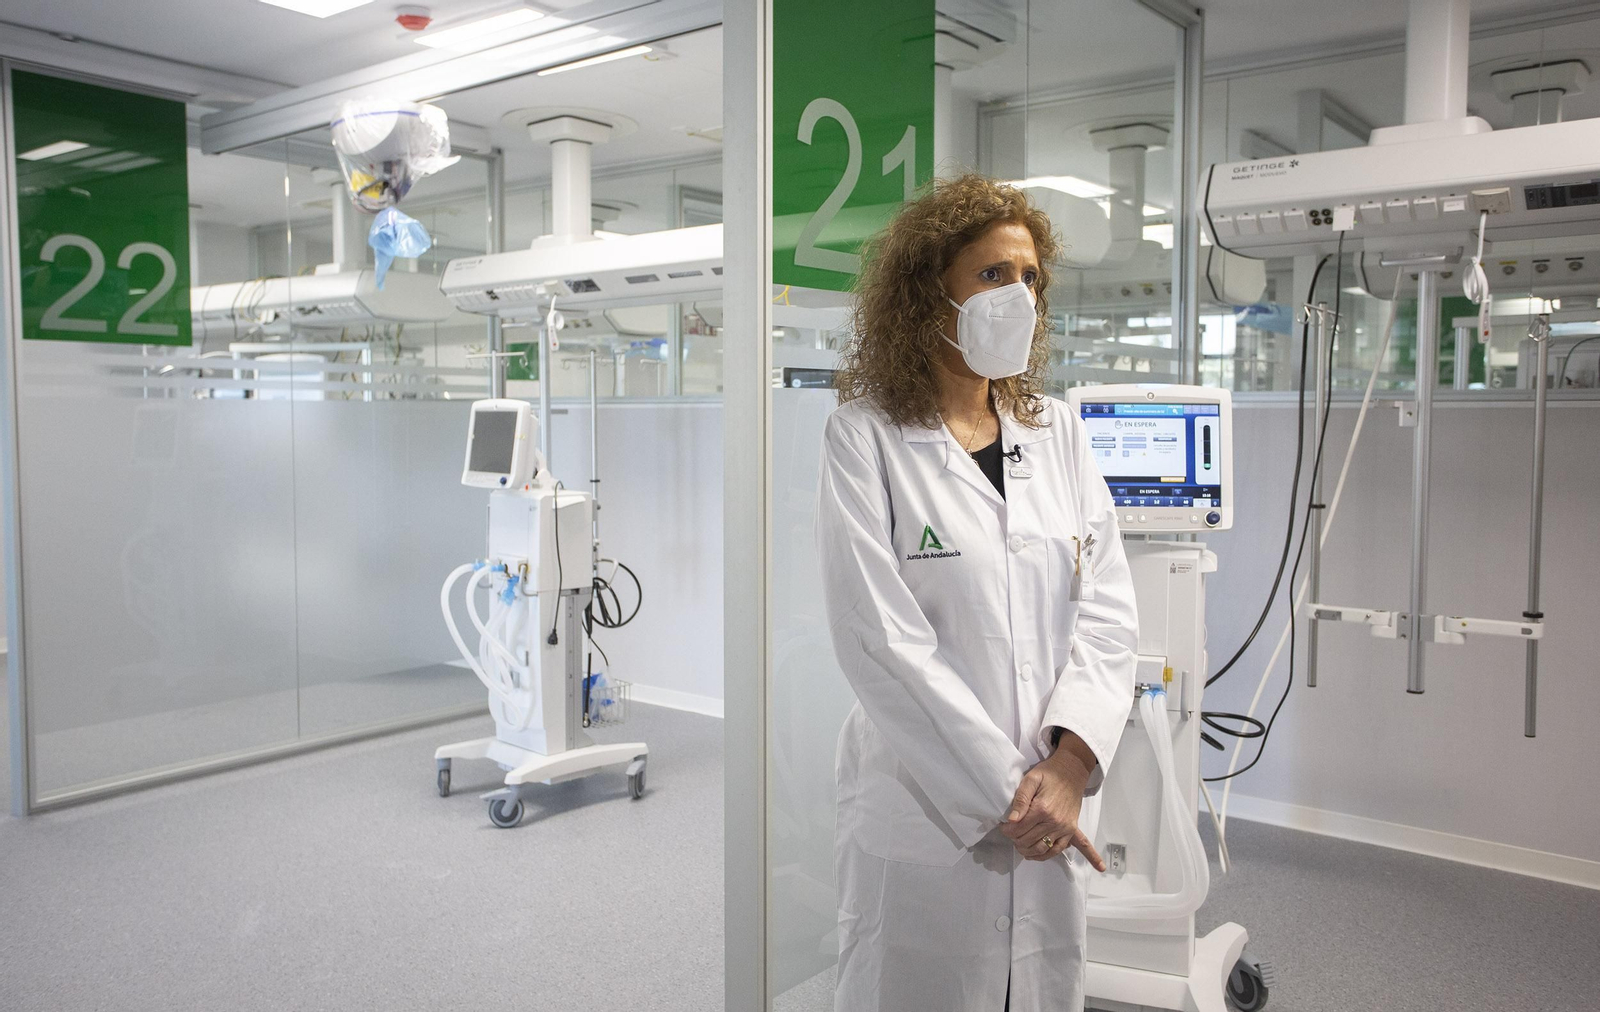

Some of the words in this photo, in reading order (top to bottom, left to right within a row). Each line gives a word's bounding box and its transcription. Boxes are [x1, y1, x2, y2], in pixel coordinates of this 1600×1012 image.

[794, 97, 916, 275] 21
[1233, 162, 1285, 173] GETINGE
[39, 233, 179, 337] 22
[930, 550, 961, 558] Andalucía
